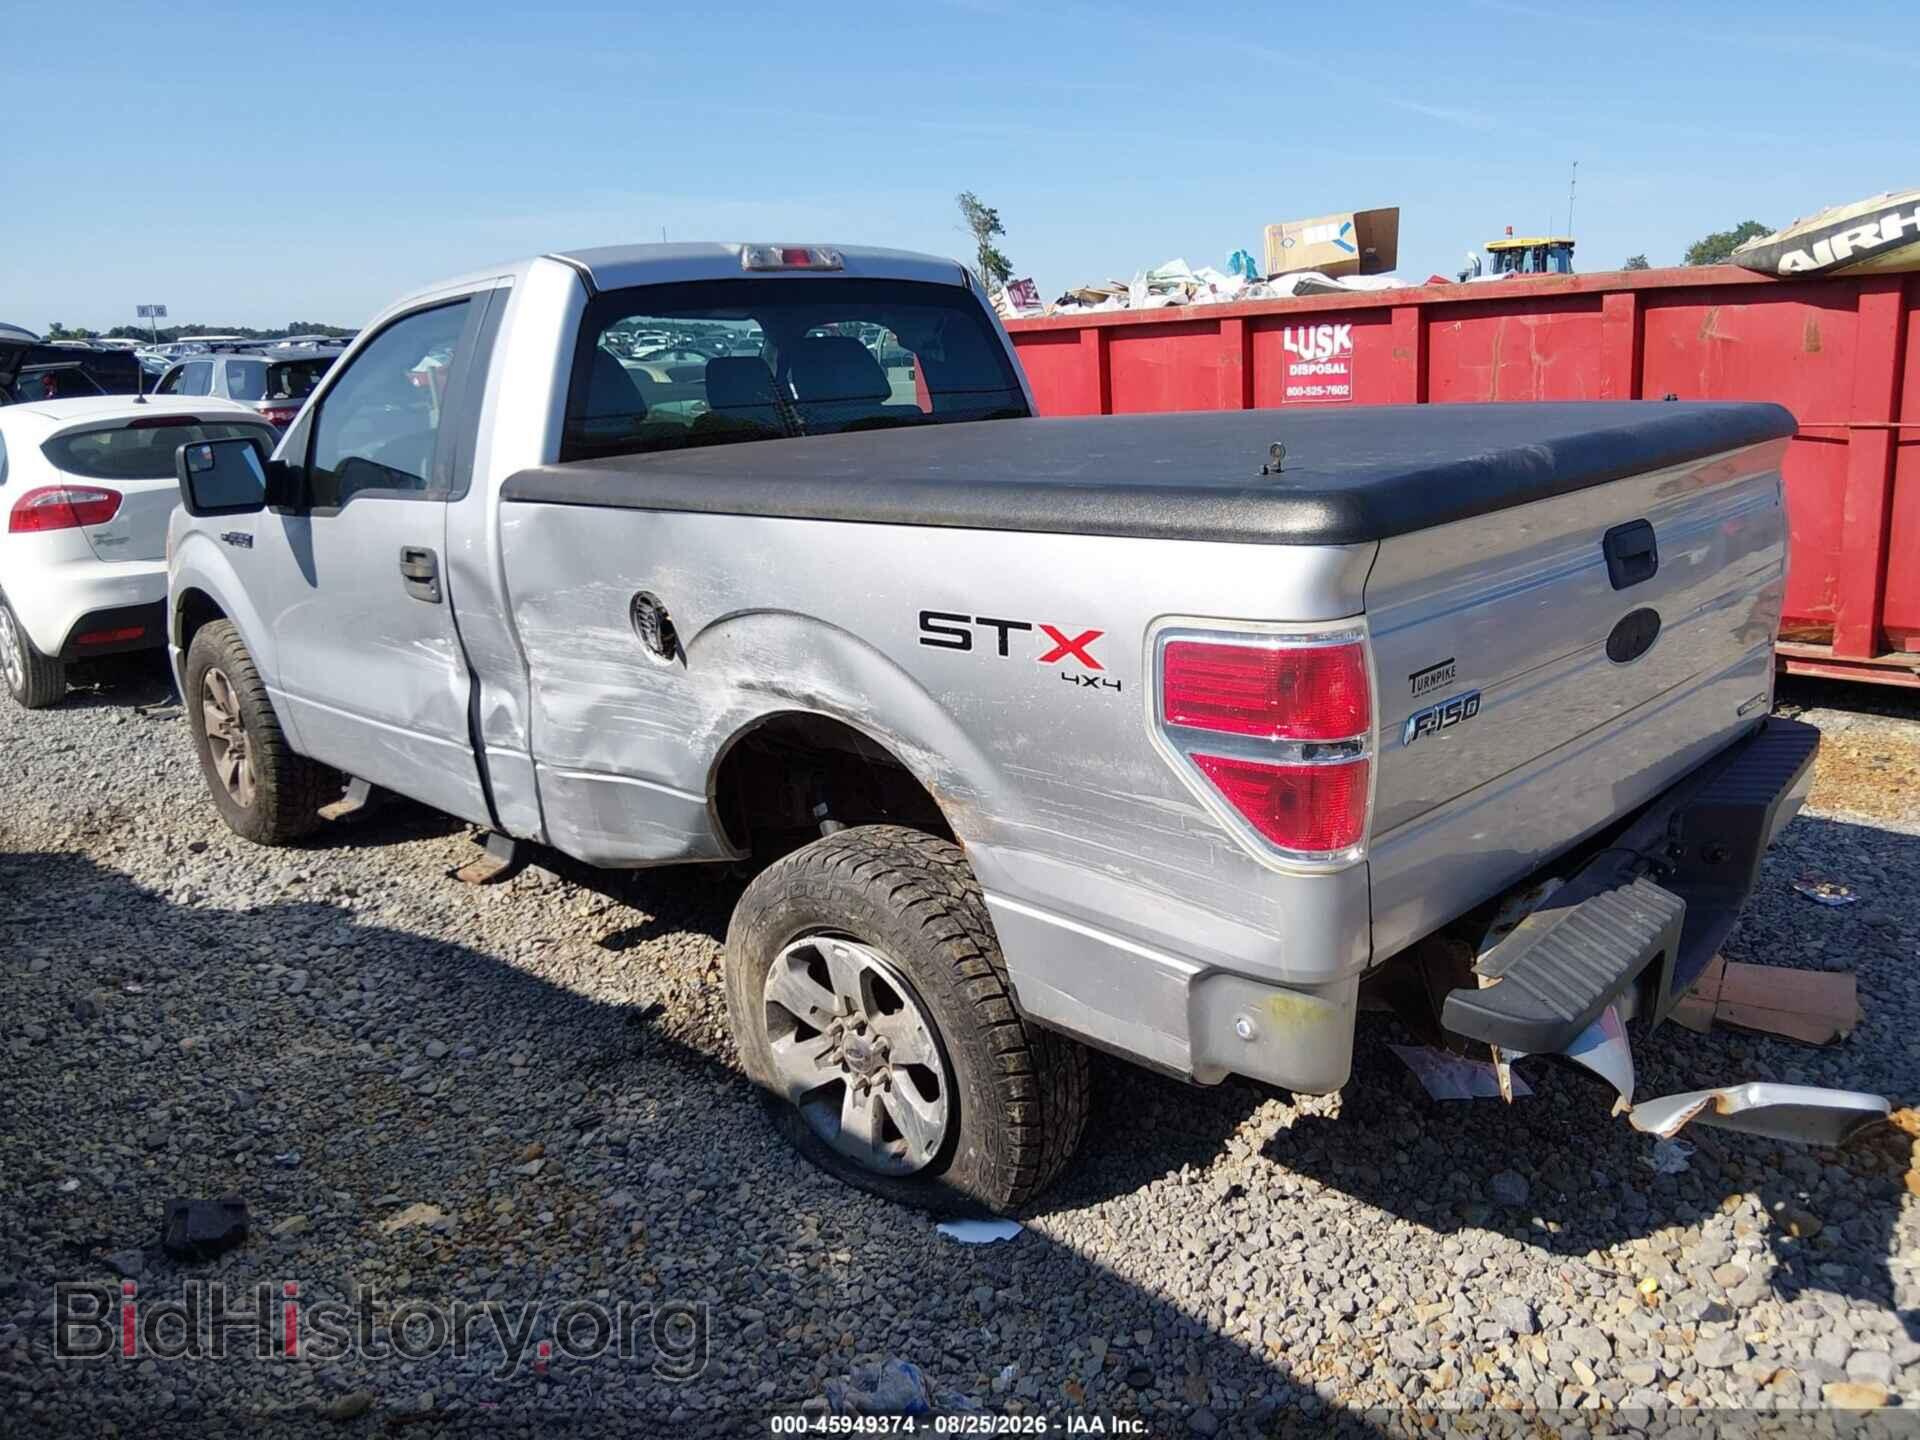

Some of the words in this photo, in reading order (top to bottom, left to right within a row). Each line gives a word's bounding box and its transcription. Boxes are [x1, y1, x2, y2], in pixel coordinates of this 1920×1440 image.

[1283, 323, 1352, 361] LUSK
[1289, 363, 1349, 376] DISPOSAL
[919, 610, 1105, 671] STX
[1409, 690, 1481, 742] F-150
